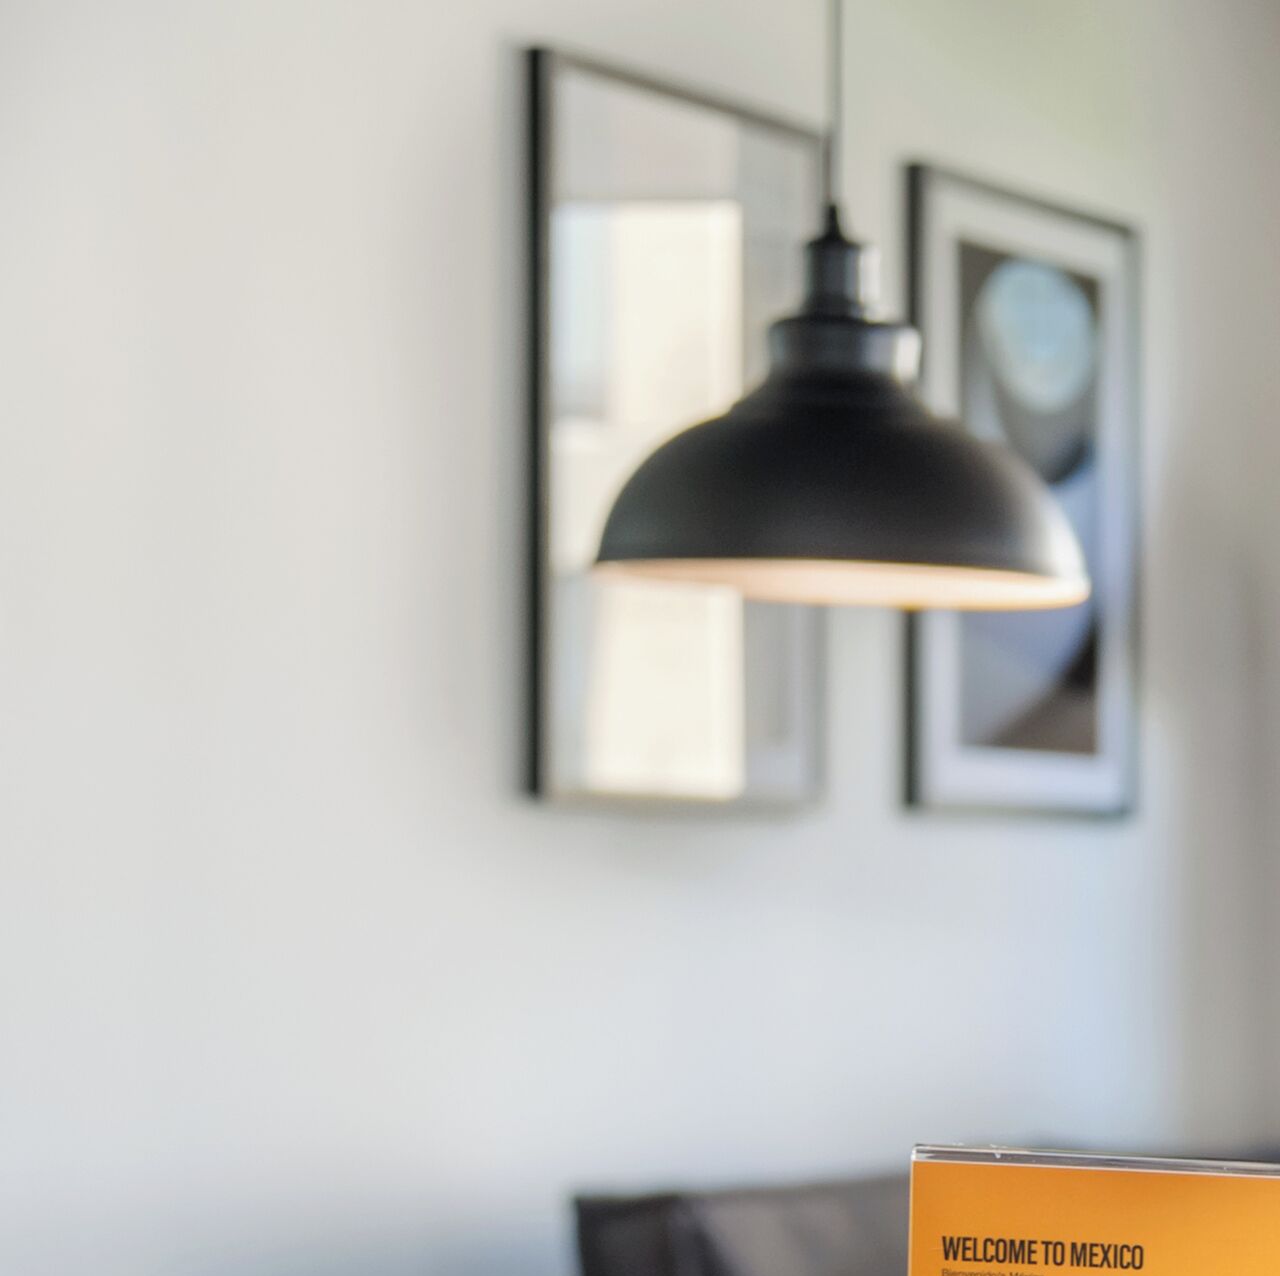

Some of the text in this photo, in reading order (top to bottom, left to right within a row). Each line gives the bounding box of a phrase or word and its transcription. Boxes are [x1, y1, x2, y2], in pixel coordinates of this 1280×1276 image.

[942, 1236, 1144, 1270] WELCOME TO MEXICO
